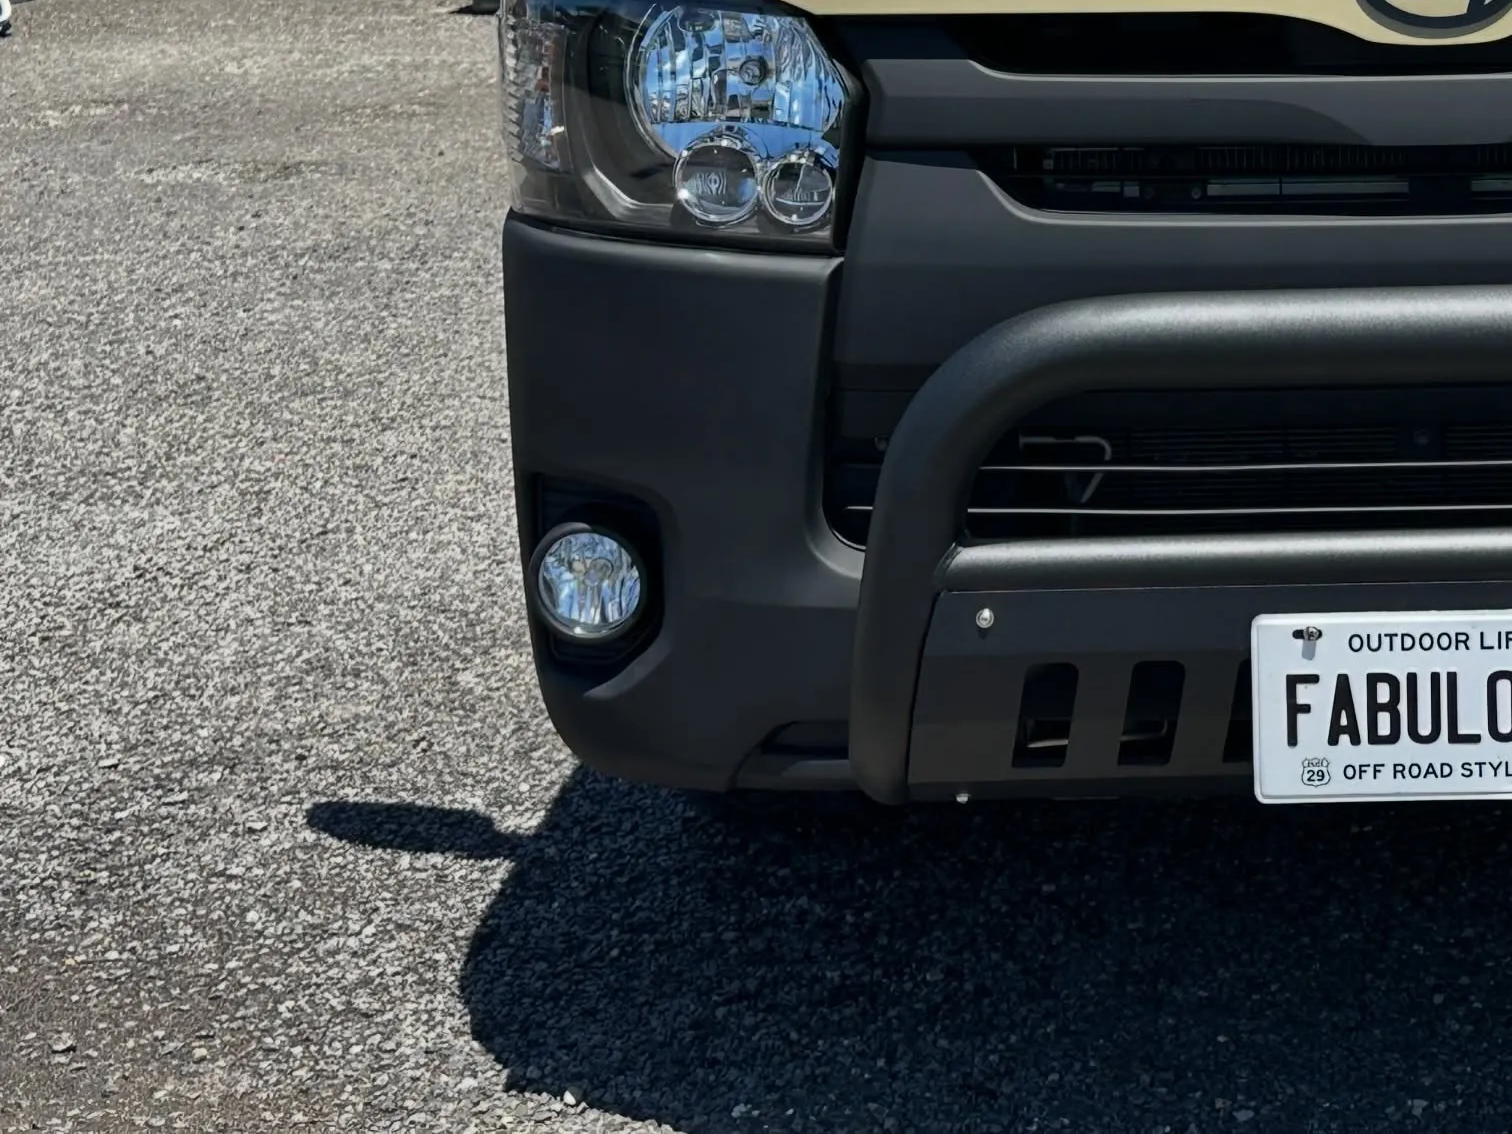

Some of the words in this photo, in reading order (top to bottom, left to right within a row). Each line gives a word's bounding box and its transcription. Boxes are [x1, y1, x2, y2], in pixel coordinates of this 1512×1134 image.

[1348, 631, 1471, 653] OUTDOOR
[1306, 769, 1326, 783] 29
[1343, 763, 1386, 780] OFF
[1392, 762, 1454, 779] ROAD
